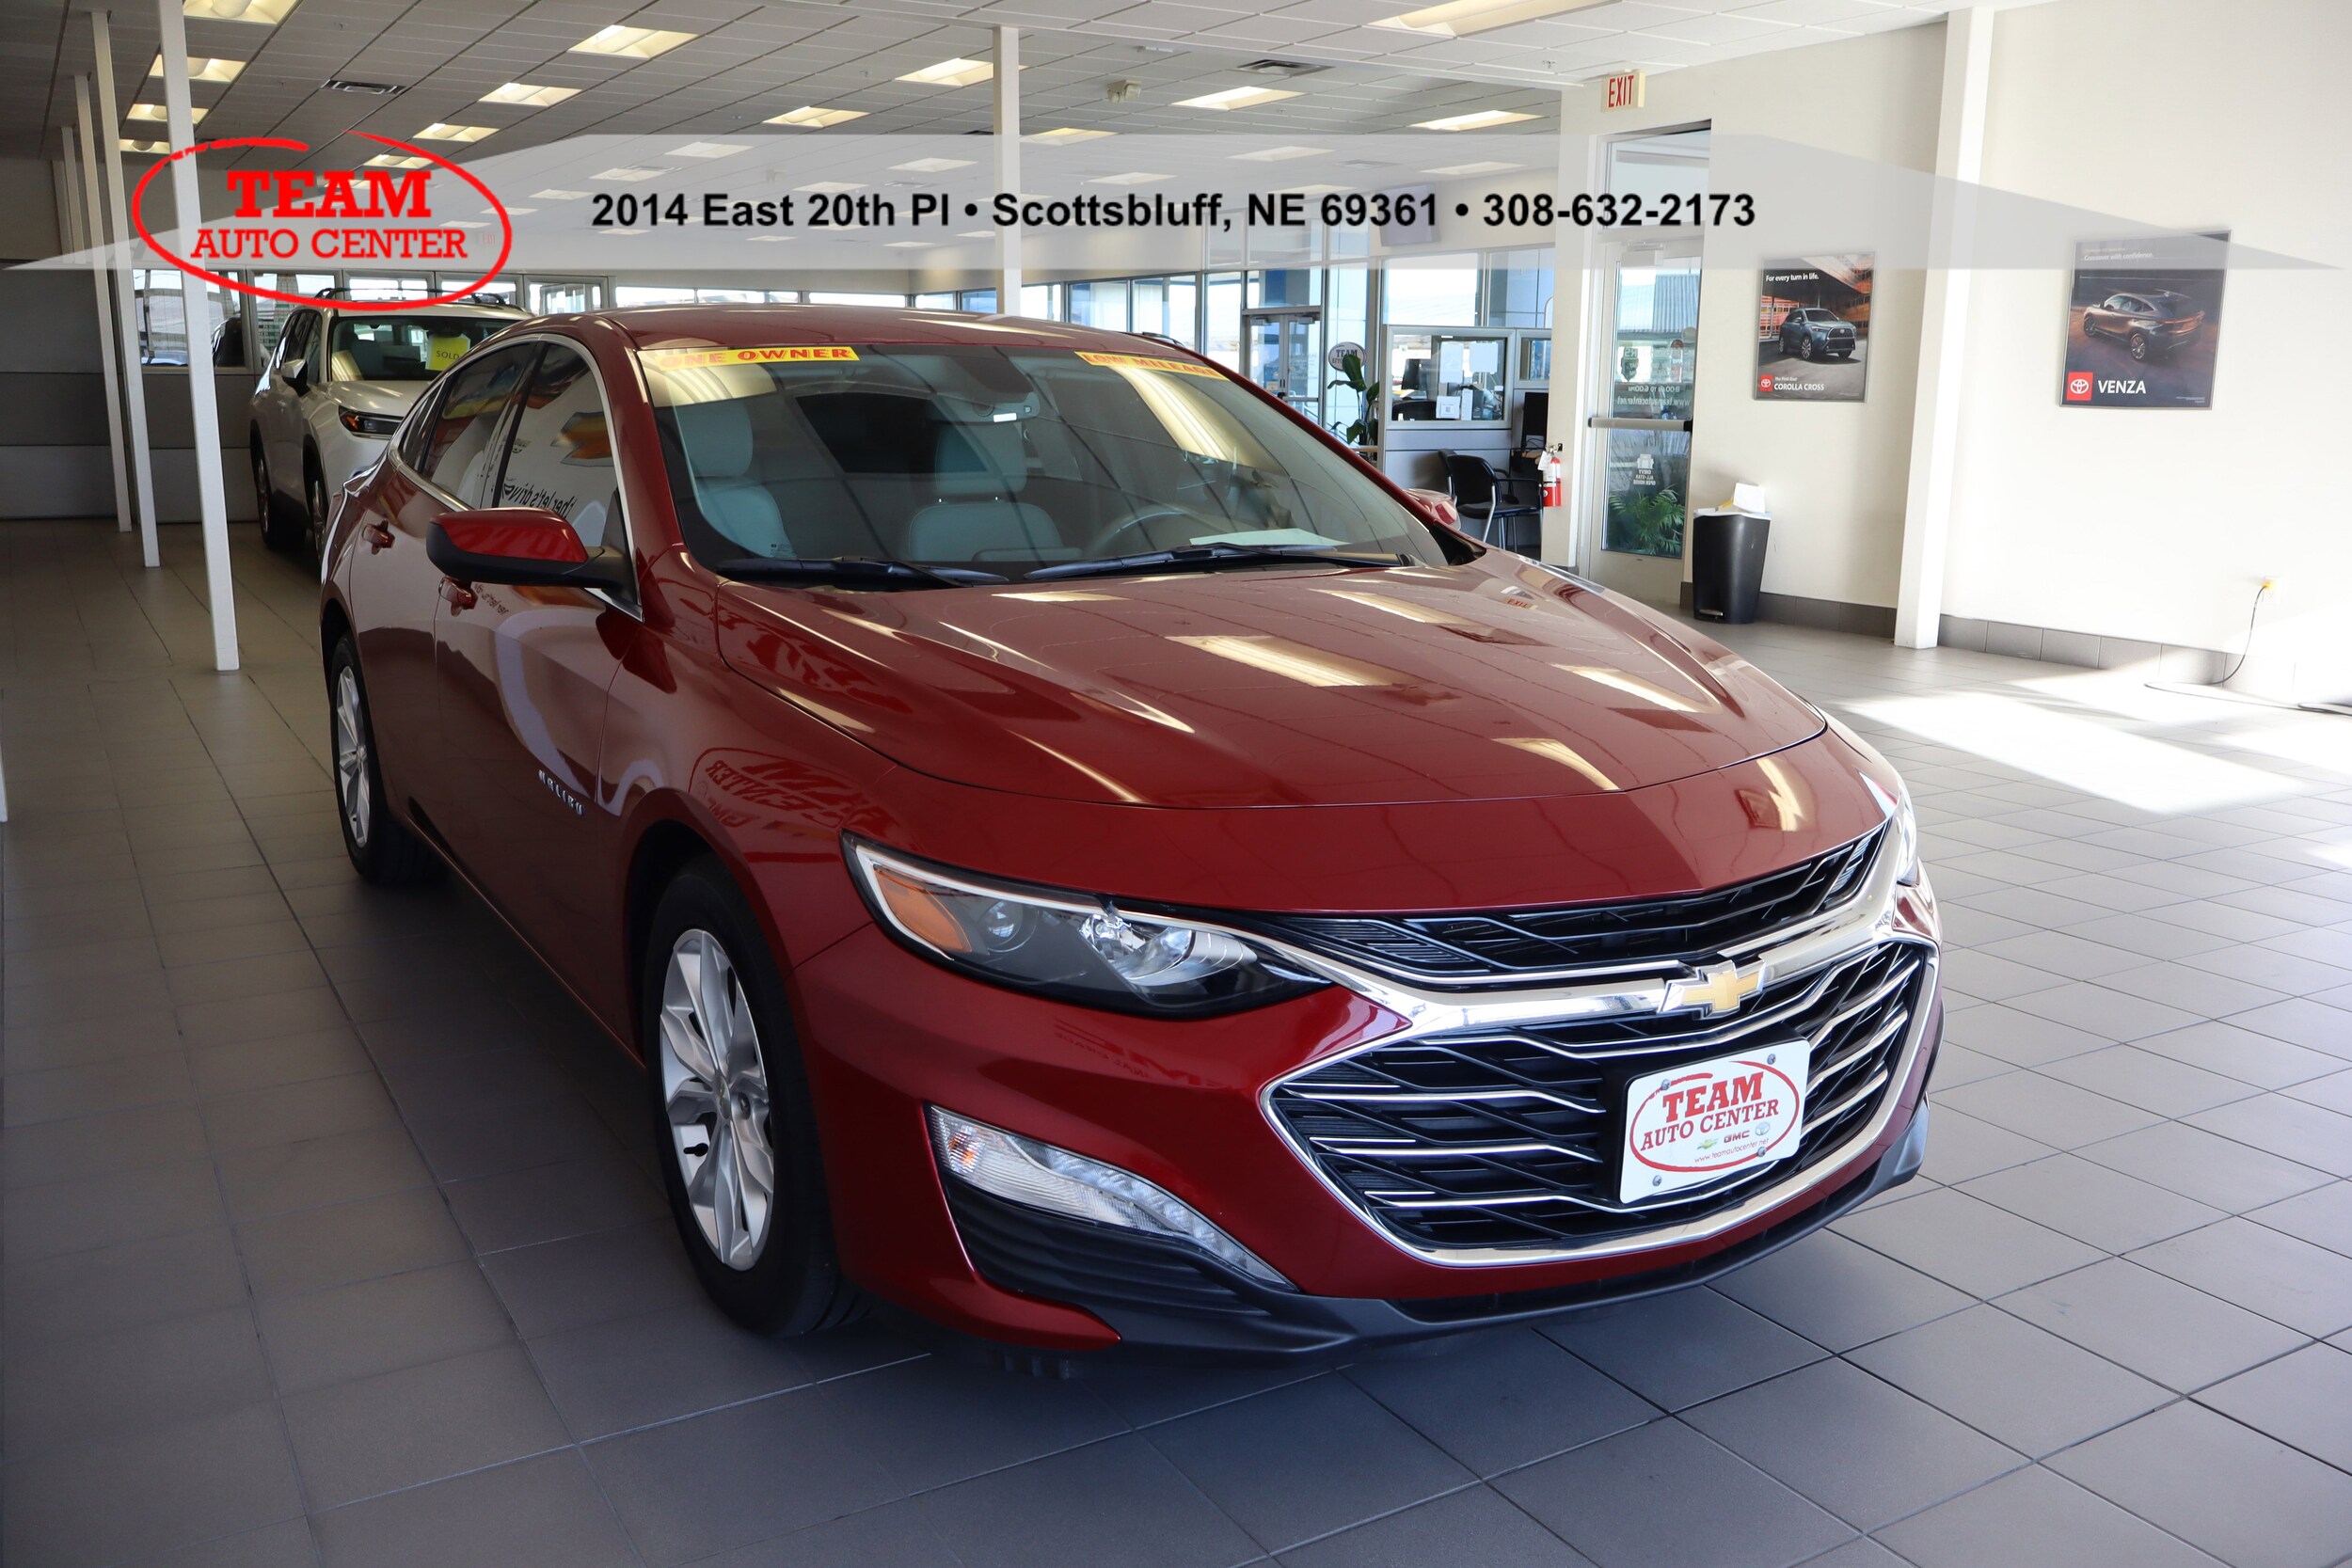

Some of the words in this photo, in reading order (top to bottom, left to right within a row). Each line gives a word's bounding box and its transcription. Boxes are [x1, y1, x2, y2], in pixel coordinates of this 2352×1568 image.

[1608, 75, 1634, 108] EXIT
[1766, 274, 1775, 282] For
[1775, 275, 1790, 283] every
[1809, 272, 1820, 280] life.
[436, 350, 460, 360] SOLD
[660, 352, 725, 369] ONE
[738, 348, 851, 360] OWNER
[1336, 349, 1359, 357] TEAM
[1083, 354, 1124, 365] LOW
[1132, 357, 1219, 376] MILEAGE
[1773, 383, 1803, 391] COROLLA
[1804, 383, 1825, 391] CROSS
[2097, 380, 2147, 394] VENZA
[538, 769, 582, 816] MALIBU
[1662, 1071, 1764, 1123] TEAM
[1640, 1120, 1694, 1152] AUTO
[1699, 1099, 1779, 1133] CENTER
[1724, 1130, 1750, 1144] GMC
[1694, 1137, 1770, 1164] www.teamautocenter.net
